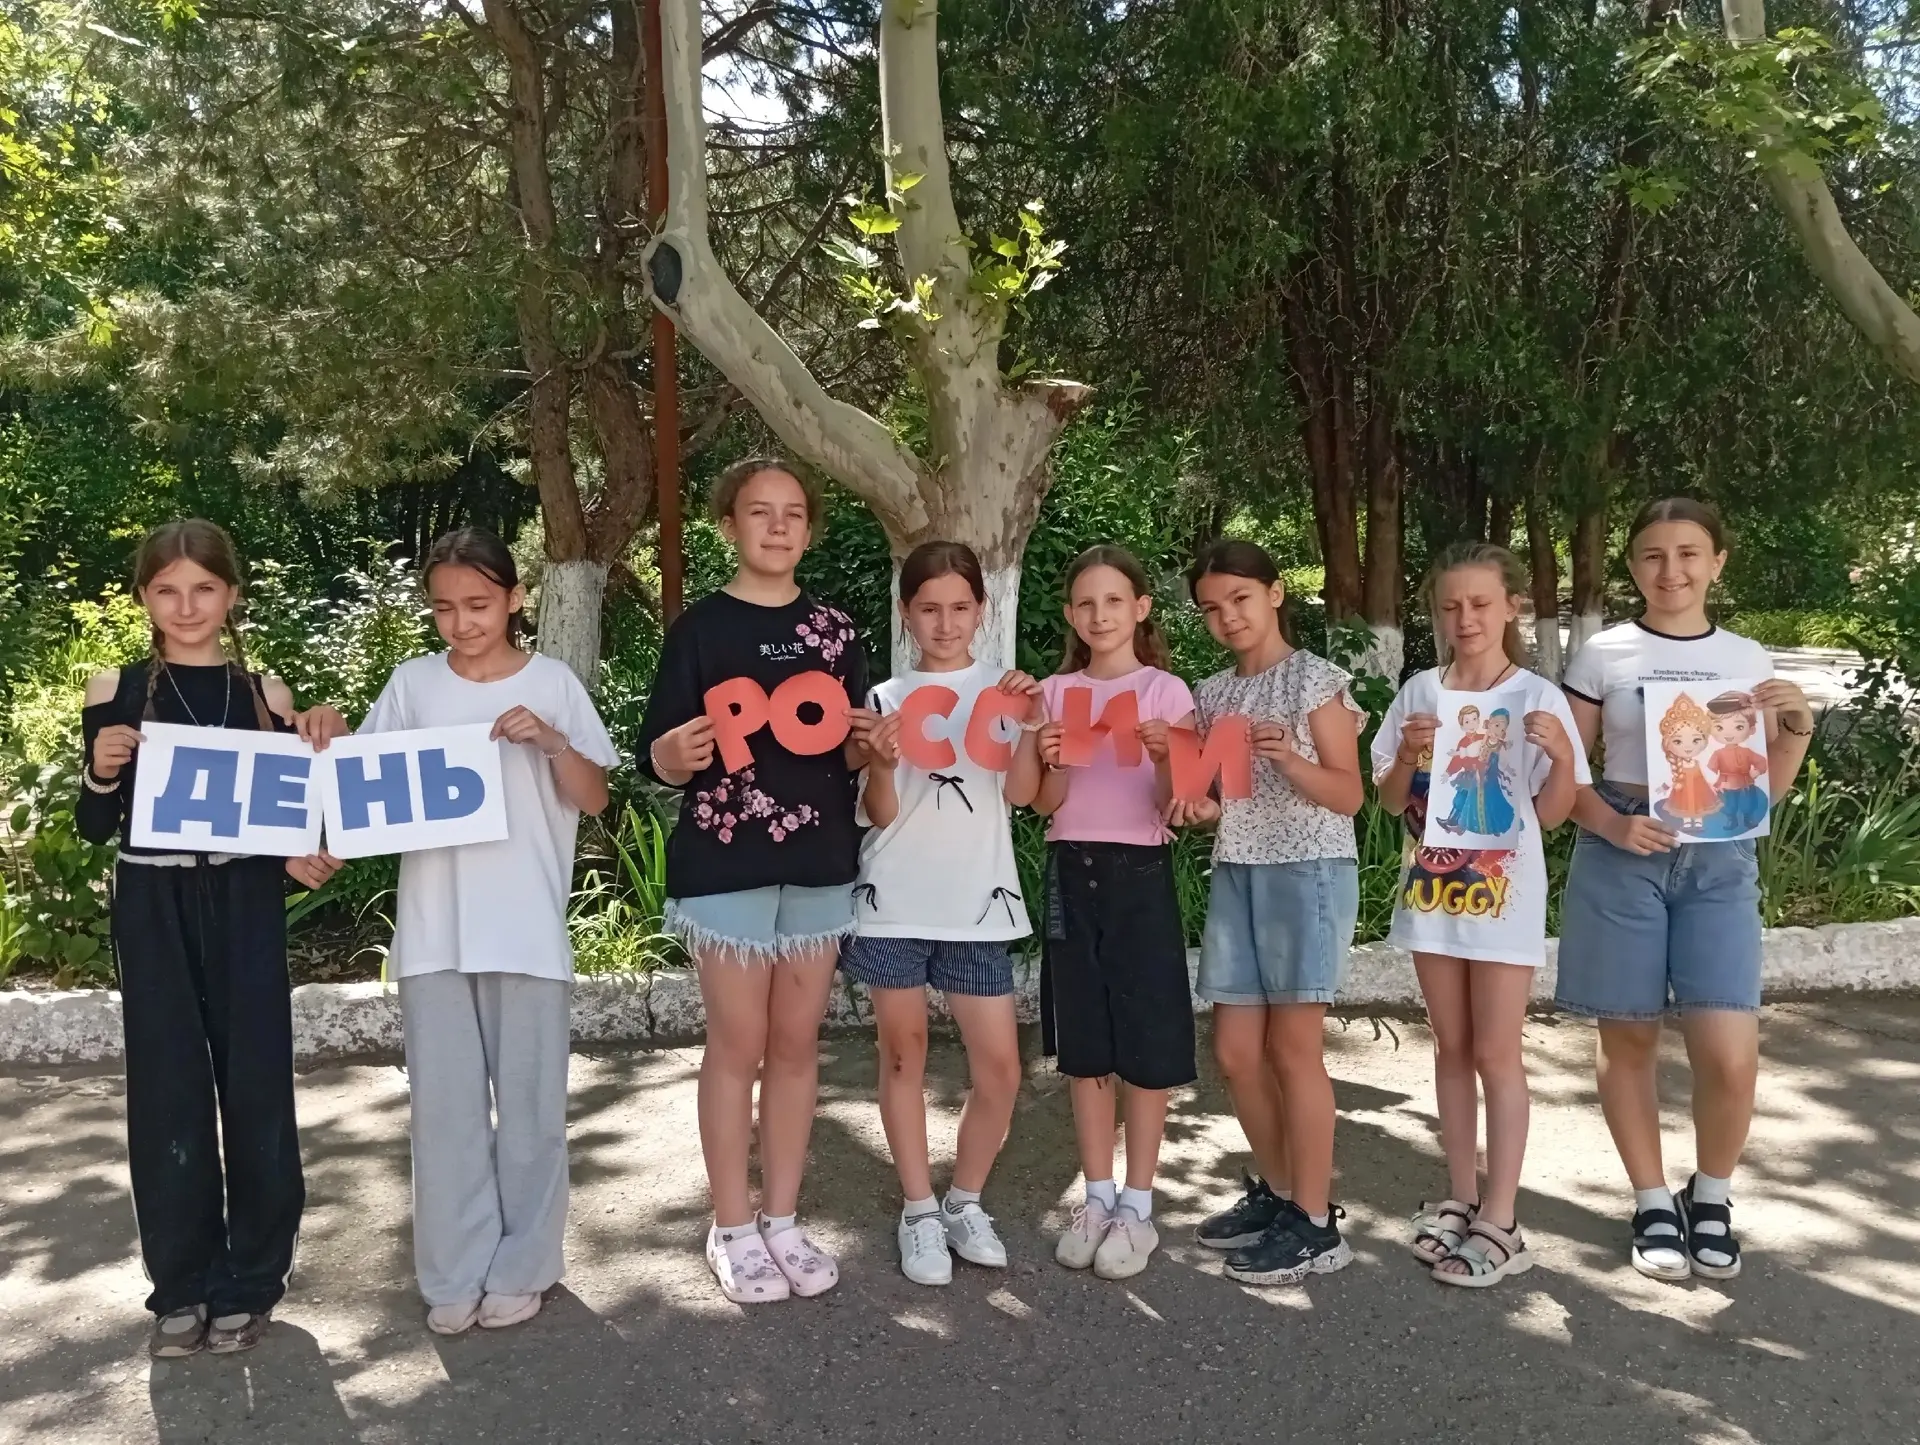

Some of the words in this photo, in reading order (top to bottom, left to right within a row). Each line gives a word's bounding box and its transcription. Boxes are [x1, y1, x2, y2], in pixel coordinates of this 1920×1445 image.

[759, 642, 805, 656] 美しい花
[151, 746, 486, 838] ДЕНЬ
